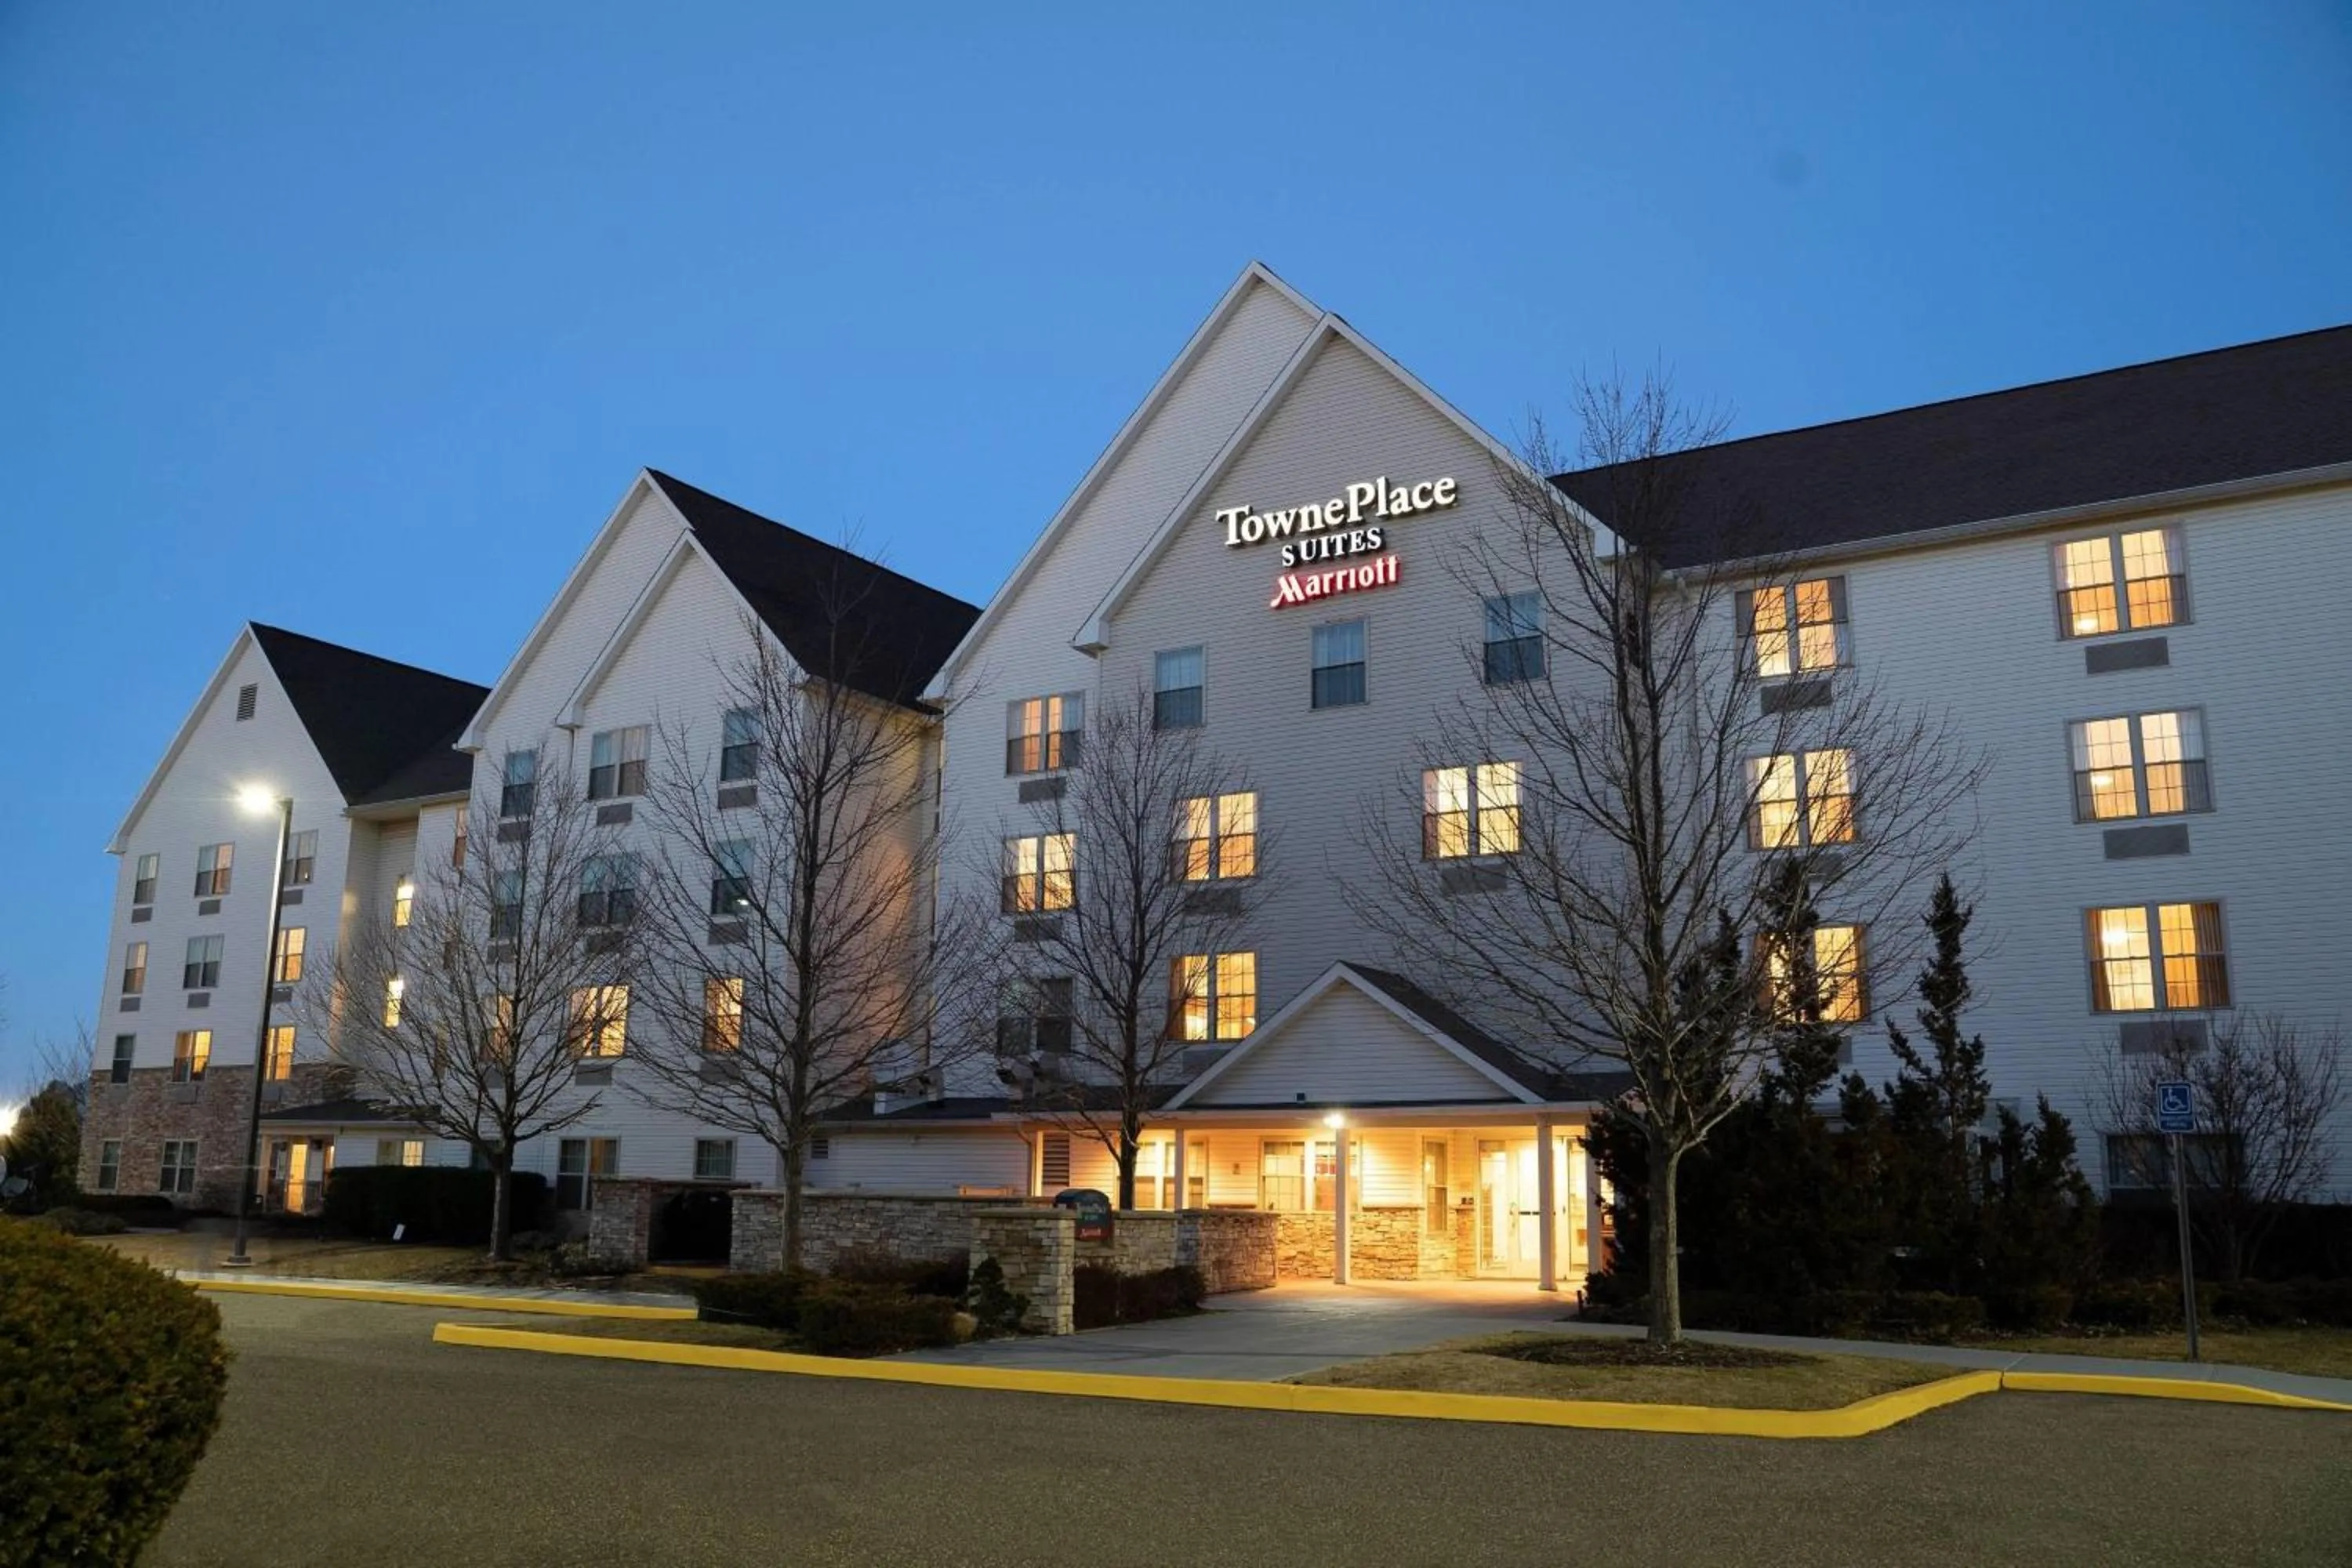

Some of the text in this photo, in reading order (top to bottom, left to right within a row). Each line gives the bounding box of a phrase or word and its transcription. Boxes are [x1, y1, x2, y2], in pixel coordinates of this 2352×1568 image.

[1216, 476, 1456, 546] TownePlace
[1281, 527, 1385, 567] SUITES
[1270, 554, 1400, 608] Marriott
